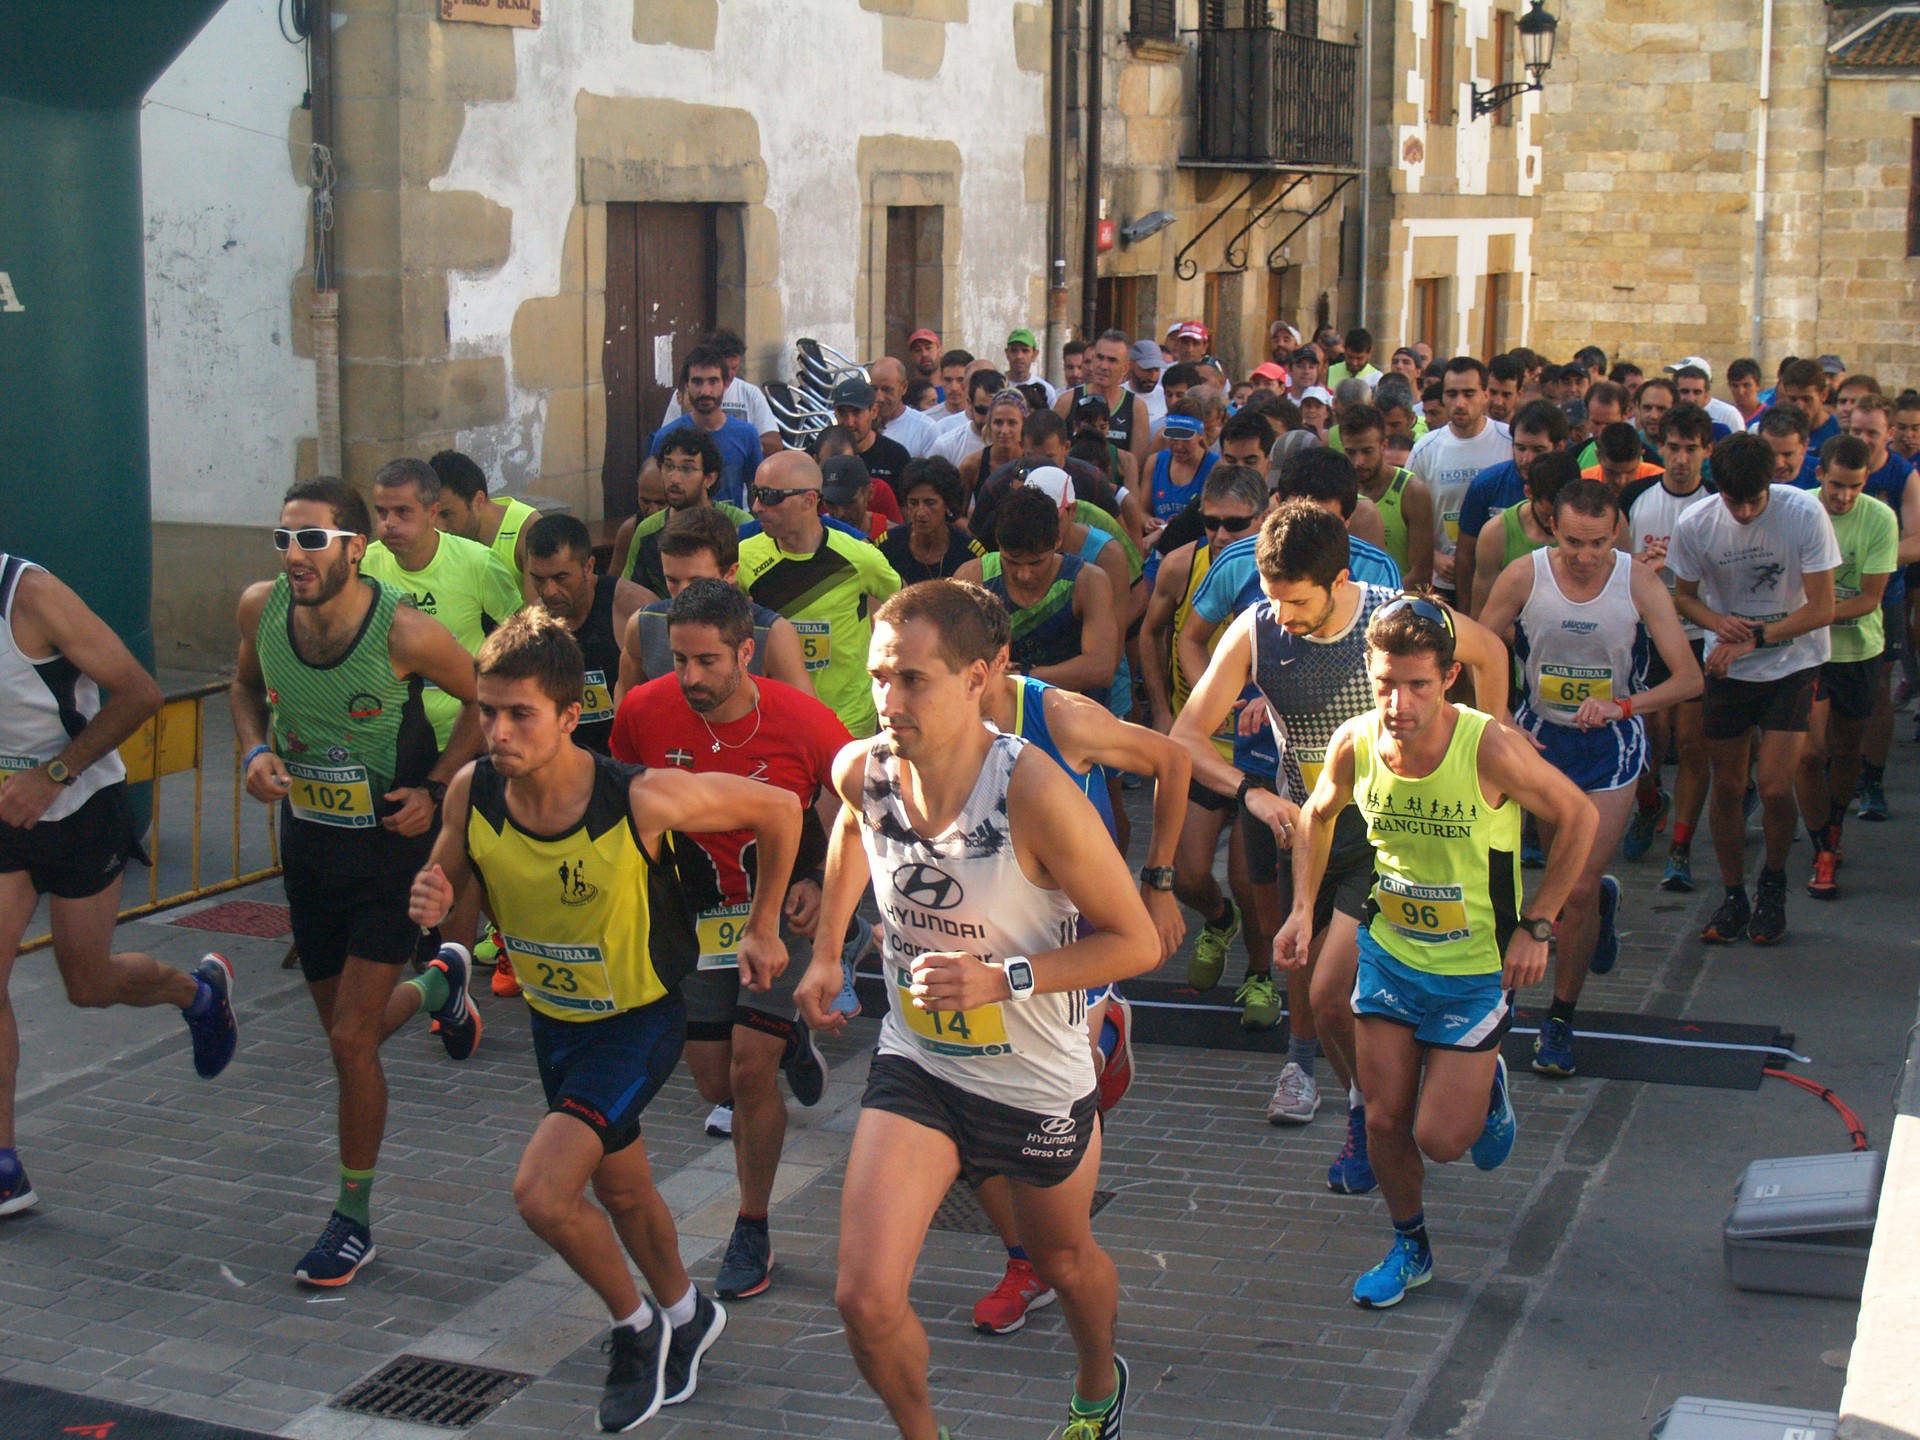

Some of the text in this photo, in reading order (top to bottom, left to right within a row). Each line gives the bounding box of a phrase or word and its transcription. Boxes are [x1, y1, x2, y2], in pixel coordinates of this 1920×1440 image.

[1546, 667, 1608, 677] CAJA RURAL
[1561, 682, 1591, 702] 65
[290, 766, 360, 781] CAJA RURAL
[303, 784, 354, 811] 102
[1371, 817, 1472, 838] RANGUREN
[1383, 879, 1456, 899] CAJA RURAL
[884, 902, 986, 938] HYUNDAI
[1401, 901, 1439, 929] 96
[512, 940, 596, 961] CAJA RURAL
[537, 962, 578, 993] 23
[926, 1010, 971, 1040] 14
[1026, 1132, 1077, 1145] HYUNDAI
[1021, 1147, 1074, 1158] Oarso Car
